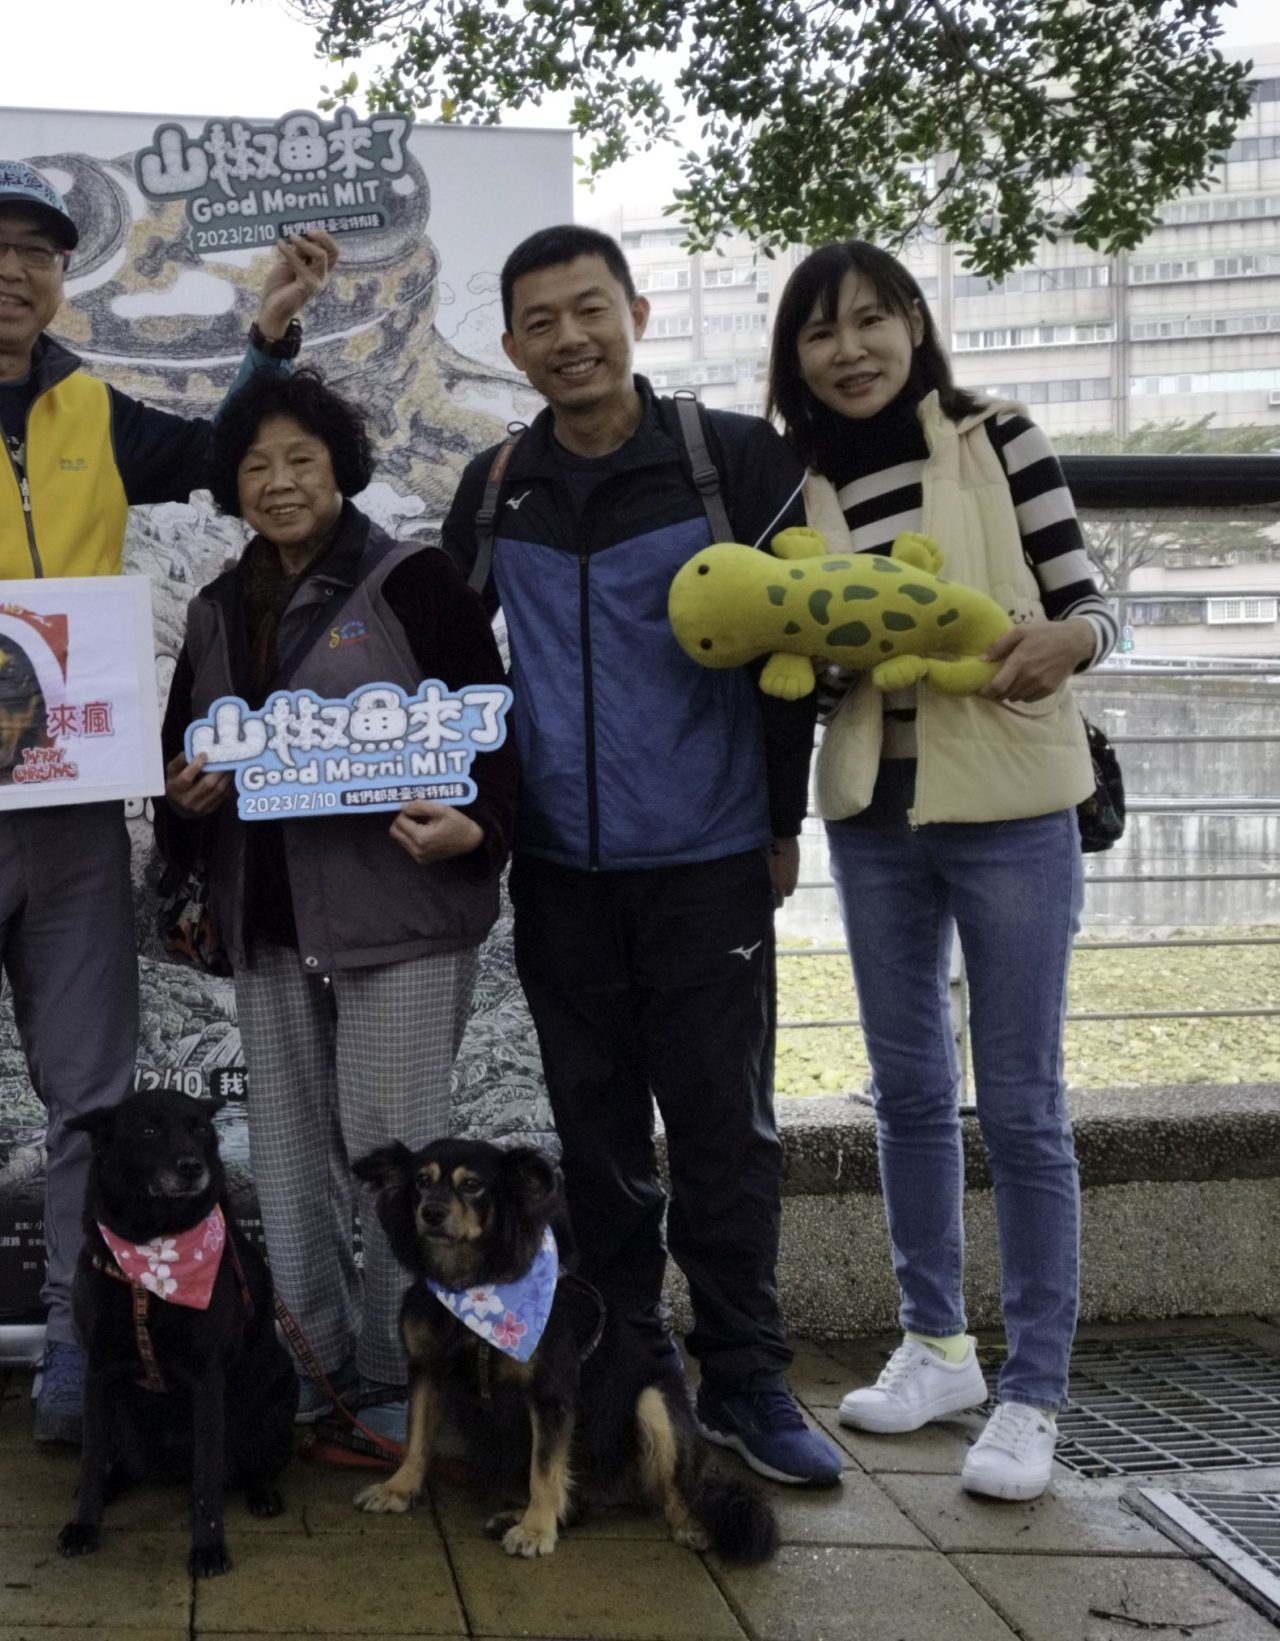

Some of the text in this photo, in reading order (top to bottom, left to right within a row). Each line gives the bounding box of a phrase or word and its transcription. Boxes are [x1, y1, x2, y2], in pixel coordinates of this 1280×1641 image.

[192, 179, 381, 223] Good Morni MIT
[196, 224, 276, 248] 2023/2/10
[49, 701, 113, 735] 來瘋
[242, 750, 468, 791] Good Morni MIT
[244, 792, 337, 815] 2023/2/10
[220, 1072, 249, 1095] 我
